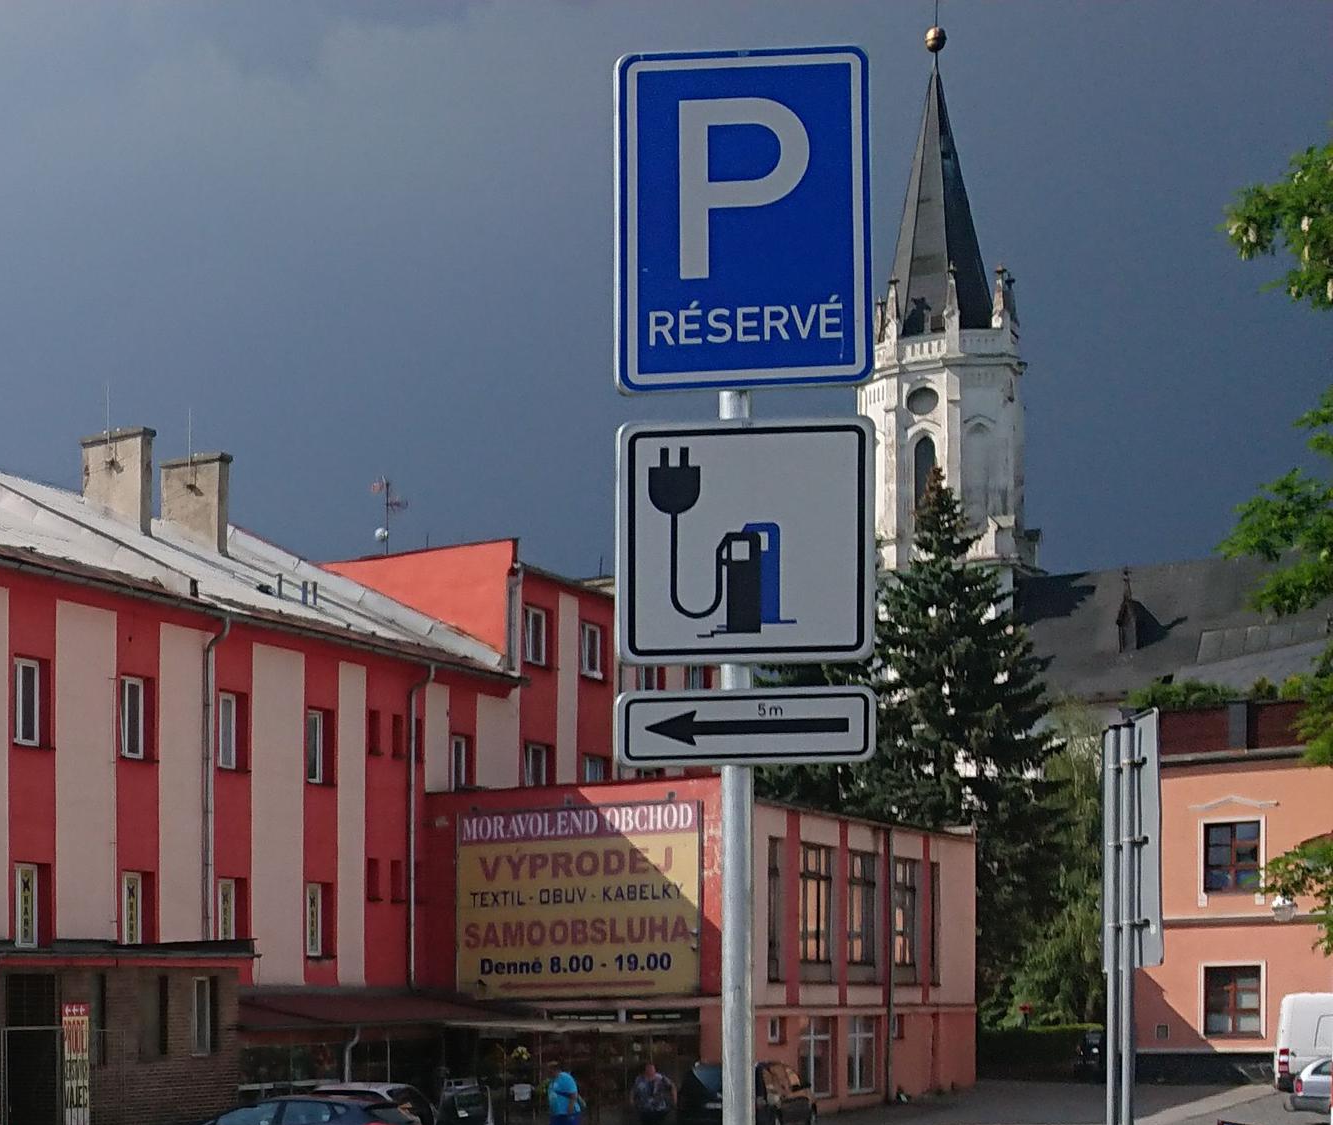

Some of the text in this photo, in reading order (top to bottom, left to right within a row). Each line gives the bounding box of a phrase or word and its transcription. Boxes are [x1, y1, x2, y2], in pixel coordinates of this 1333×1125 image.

[679, 97, 810, 280] P
[648, 294, 844, 346] RÉSERVÉ
[462, 802, 693, 841] MORAVOLEND OBCHOD
[479, 846, 674, 882] VÝPRODEJ
[470, 889, 526, 908] TEXTIL
[539, 886, 587, 904] OBUV
[602, 881, 683, 902] KABELKY
[464, 916, 691, 949] SAMOOBSLUHA
[480, 956, 543, 975] Denně
[549, 954, 594, 973] 8.00
[614, 952, 672, 972] 19.00
